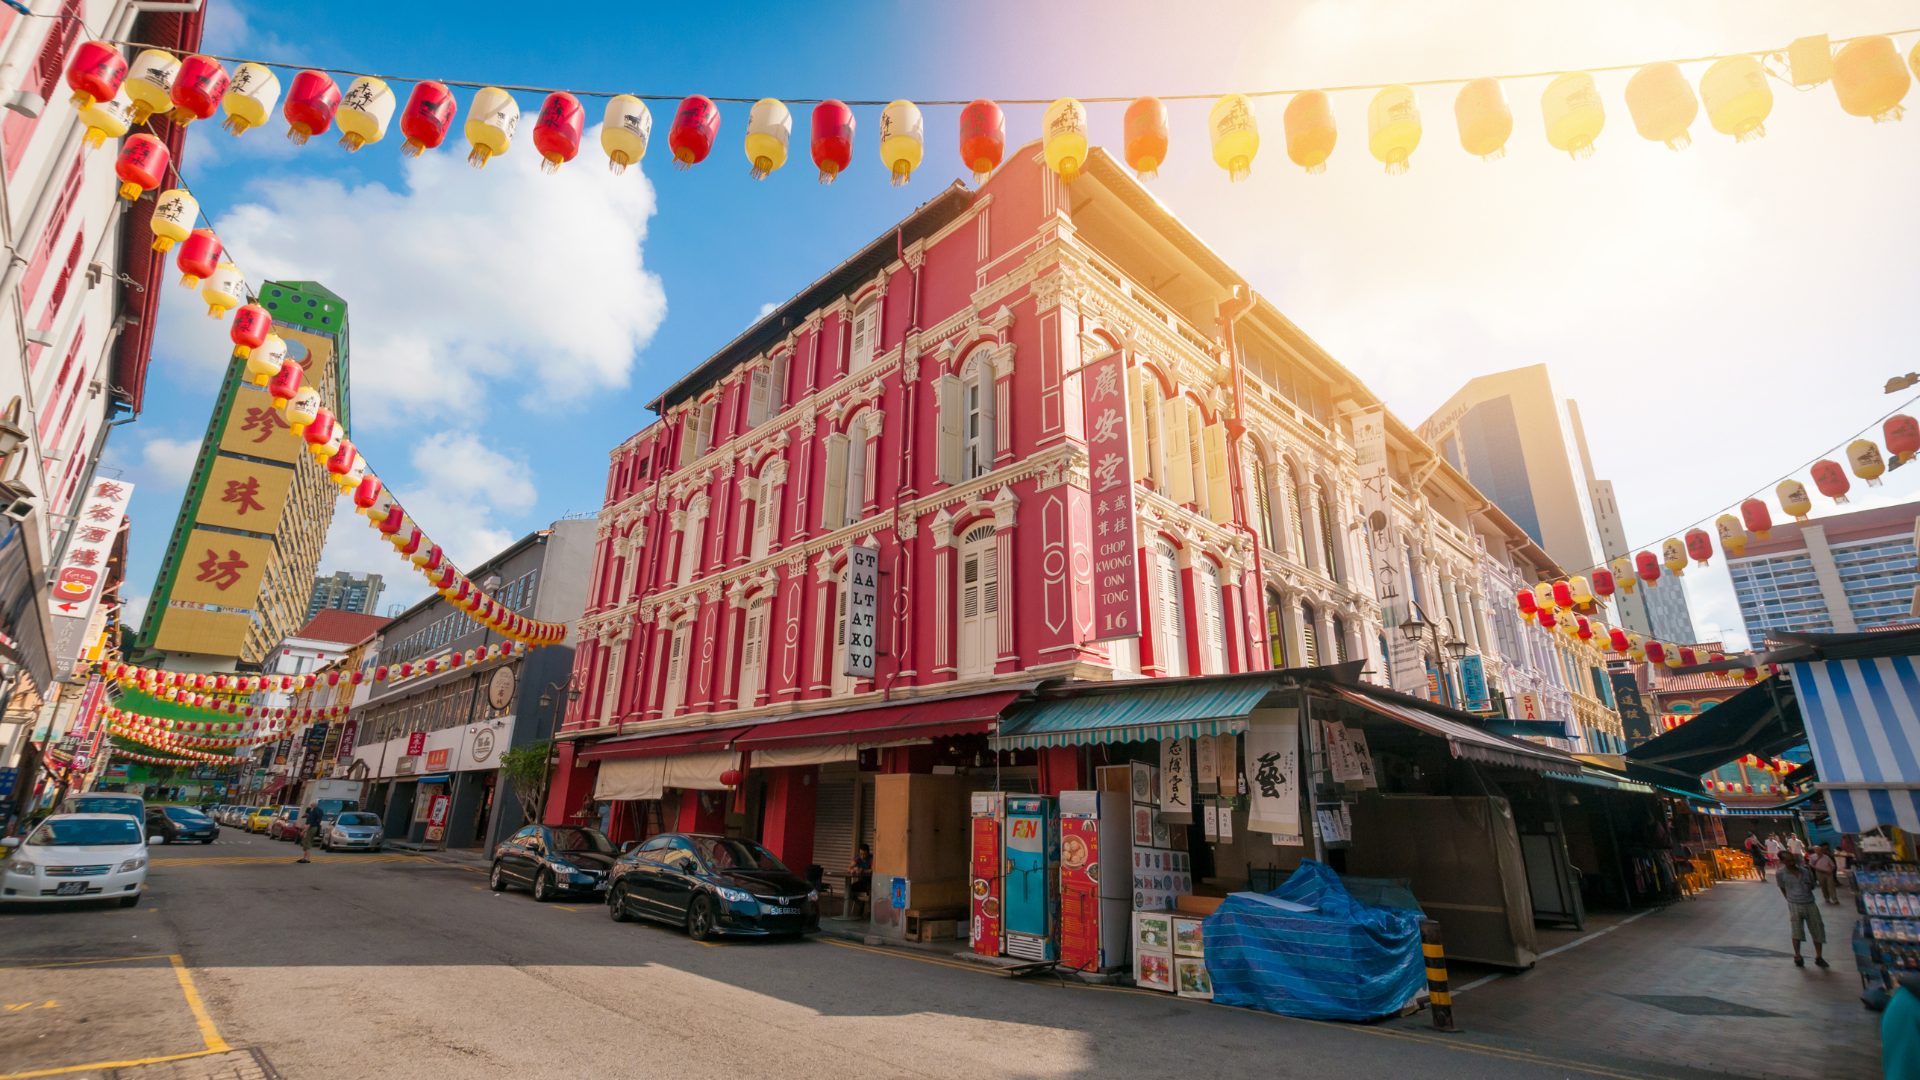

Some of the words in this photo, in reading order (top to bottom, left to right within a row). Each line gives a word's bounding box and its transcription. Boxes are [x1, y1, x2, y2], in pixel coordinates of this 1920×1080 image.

[1100, 539, 1126, 556] CHOP
[1096, 554, 1132, 573] KWONG
[1104, 573, 1125, 588] ONN
[1101, 589, 1129, 605] TONG
[850, 552, 864, 667] GALAXY
[862, 554, 876, 669] TATTOO
[1103, 610, 1128, 631] 16
[1012, 819, 1038, 839] F&N
